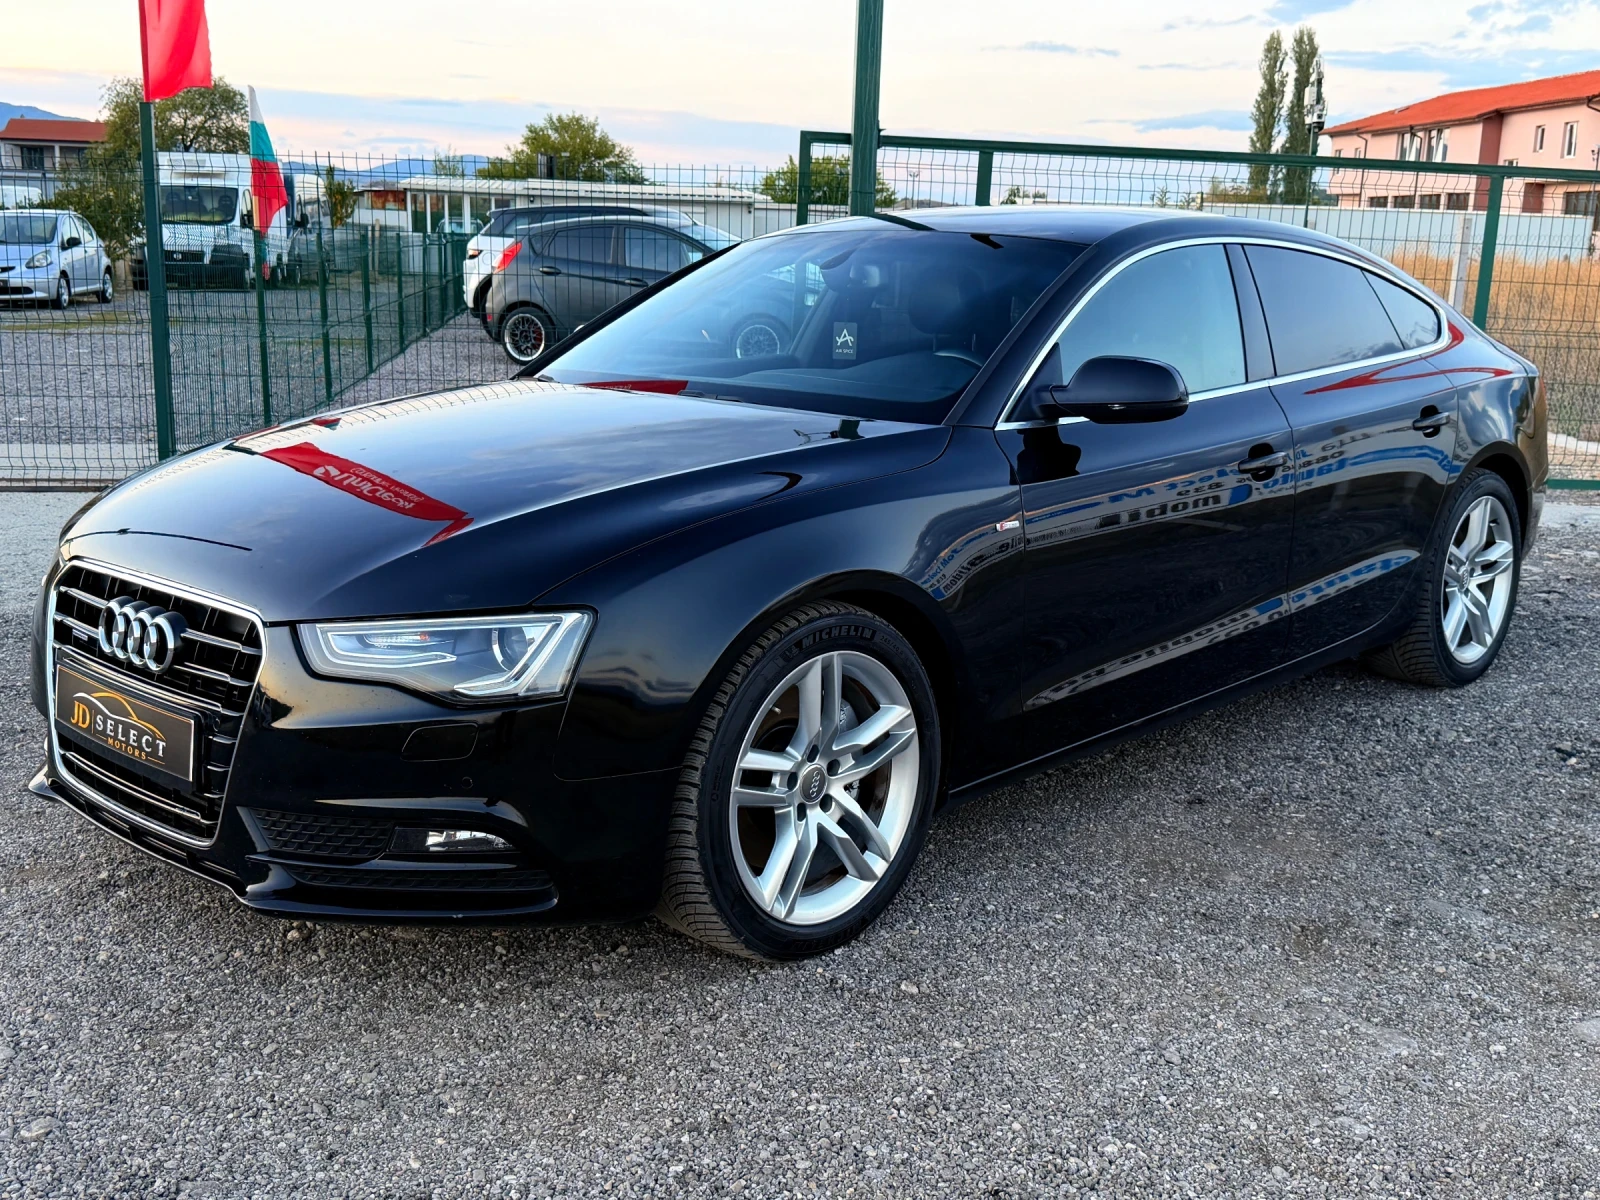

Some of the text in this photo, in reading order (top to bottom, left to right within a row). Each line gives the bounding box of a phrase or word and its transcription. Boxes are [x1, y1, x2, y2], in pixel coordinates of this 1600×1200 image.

[802, 625, 874, 649] MICHELIN
[70, 700, 166, 758] JD SELECT
[107, 737, 147, 760] MOTORS
